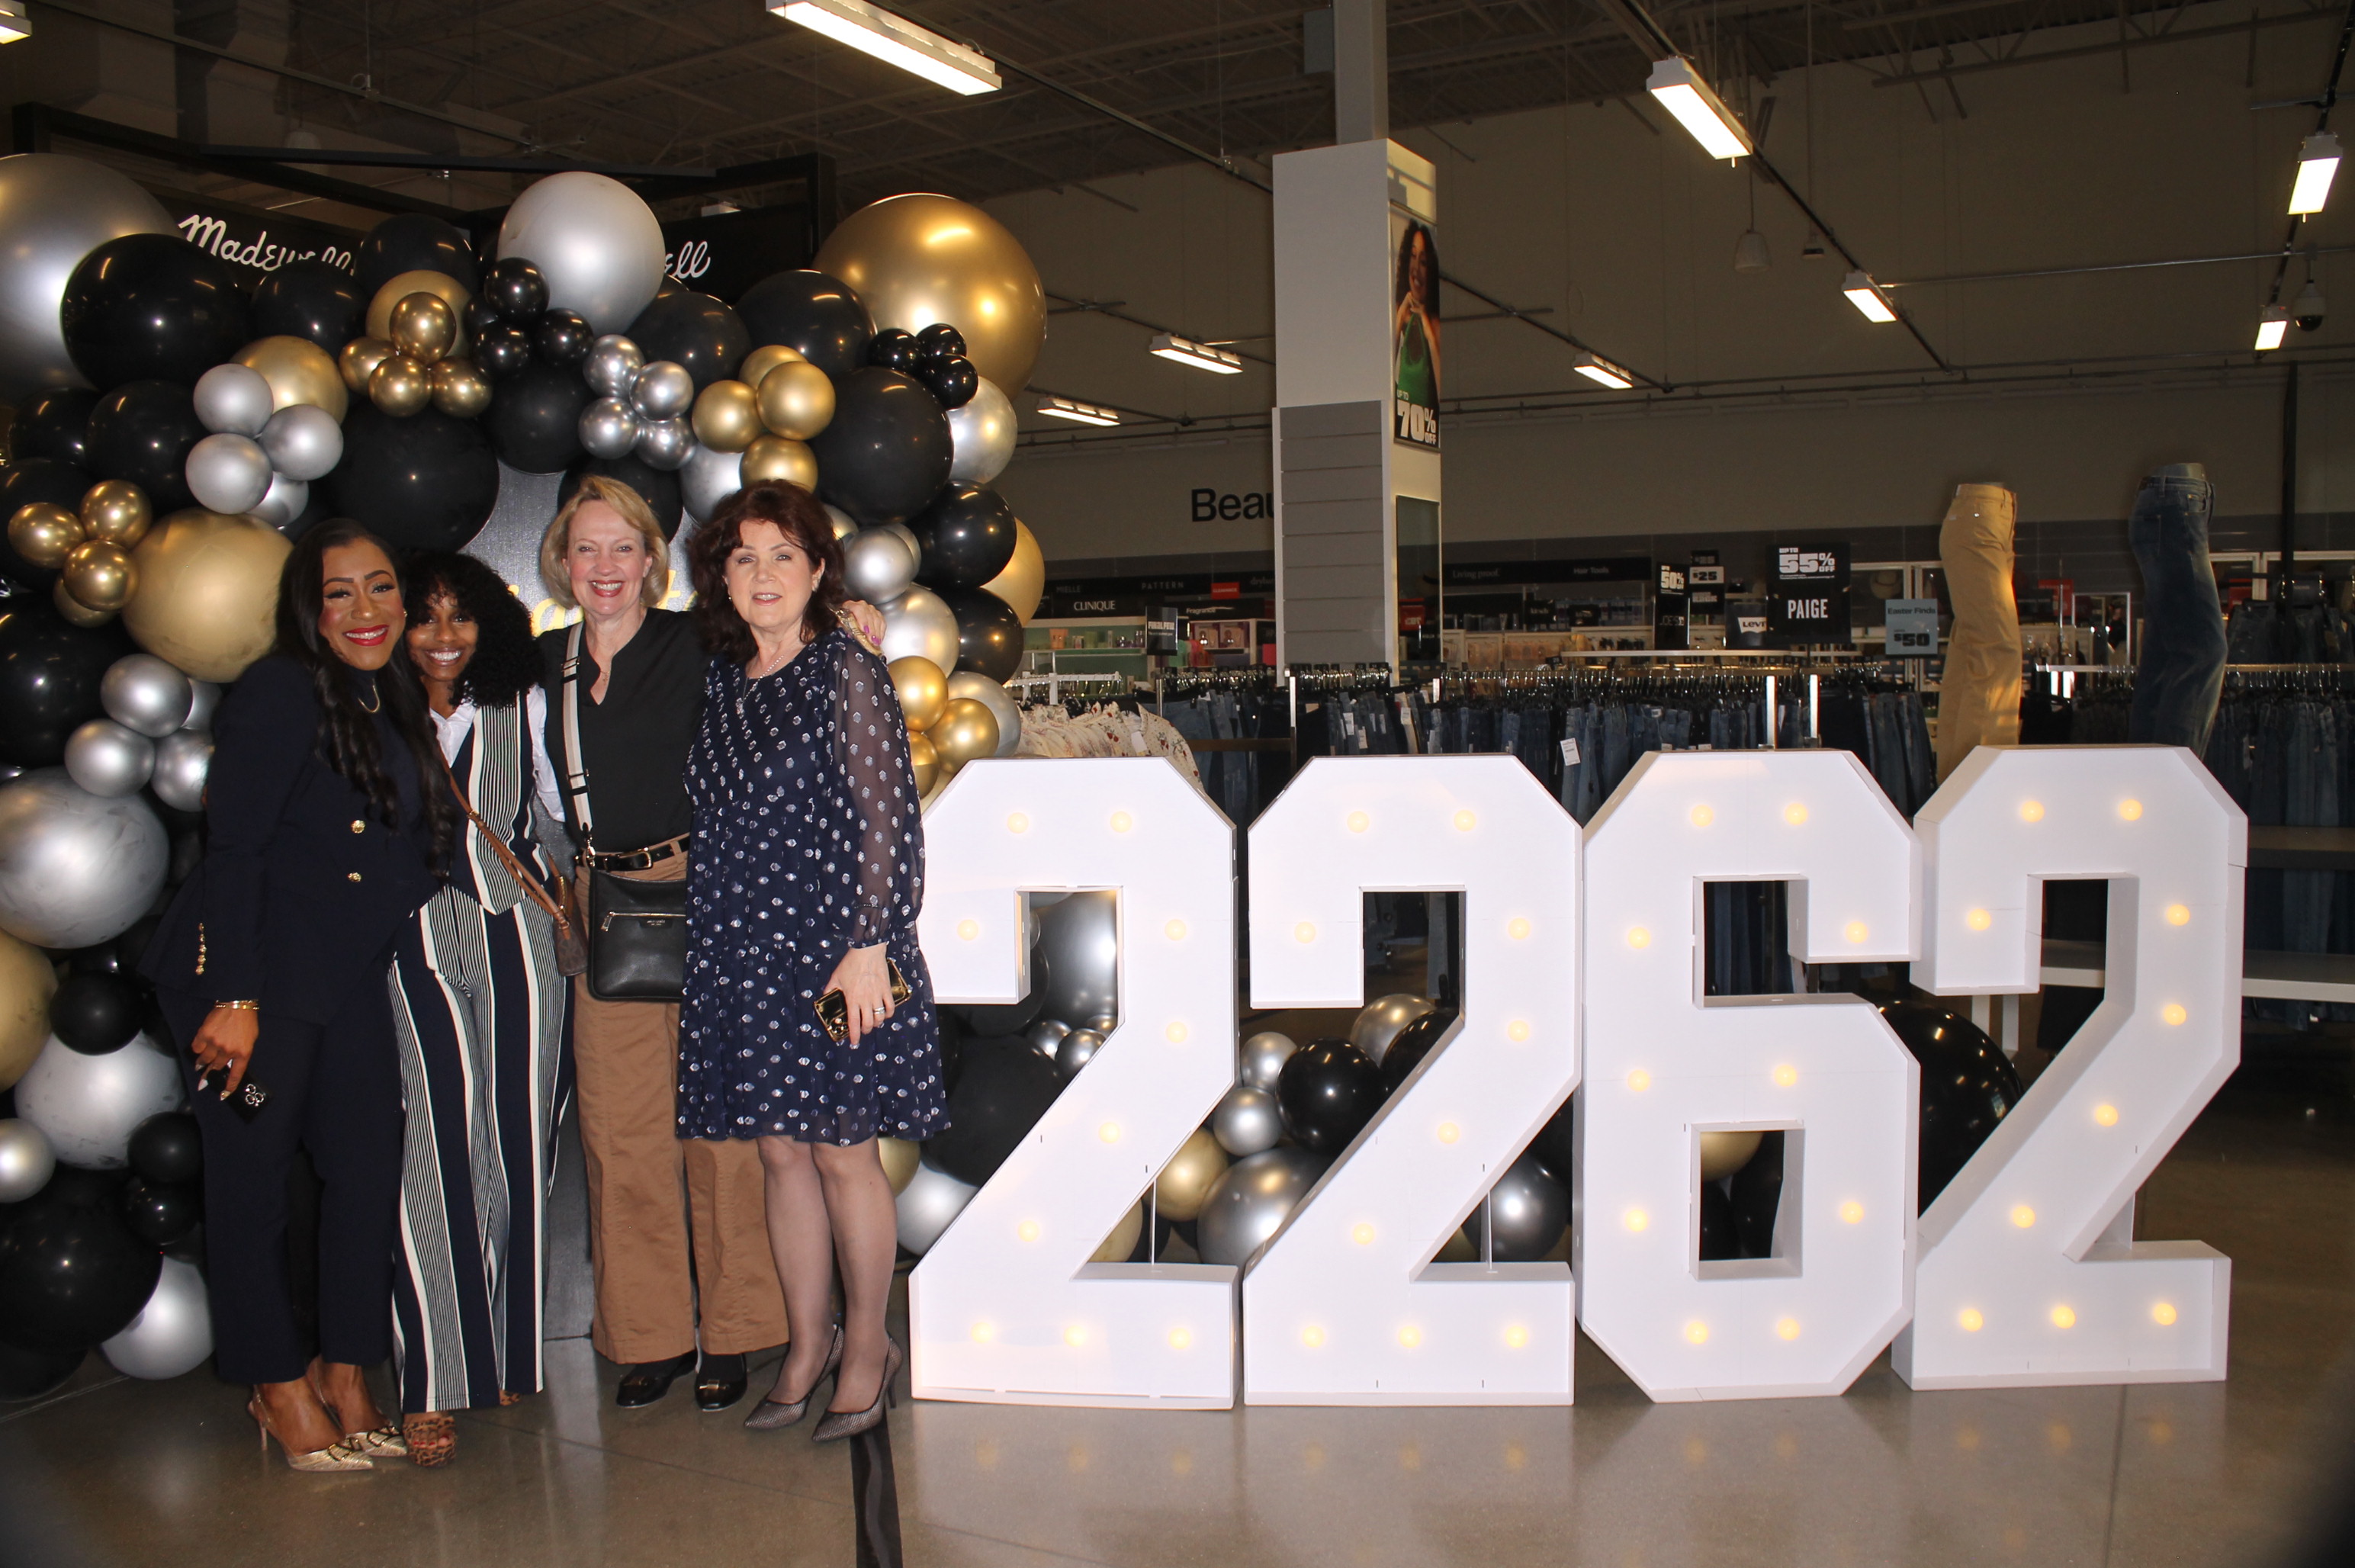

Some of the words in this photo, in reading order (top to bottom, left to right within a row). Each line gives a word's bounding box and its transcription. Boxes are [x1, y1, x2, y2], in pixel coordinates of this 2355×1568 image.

[1425, 432, 1437, 445] OFF
[1778, 552, 1836, 574] 55%
[1141, 580, 1184, 590] PATTERN
[1073, 599, 1116, 612] CLINIQUE
[1787, 598, 1829, 619] PAIGE
[1894, 633, 1930, 647] $50
